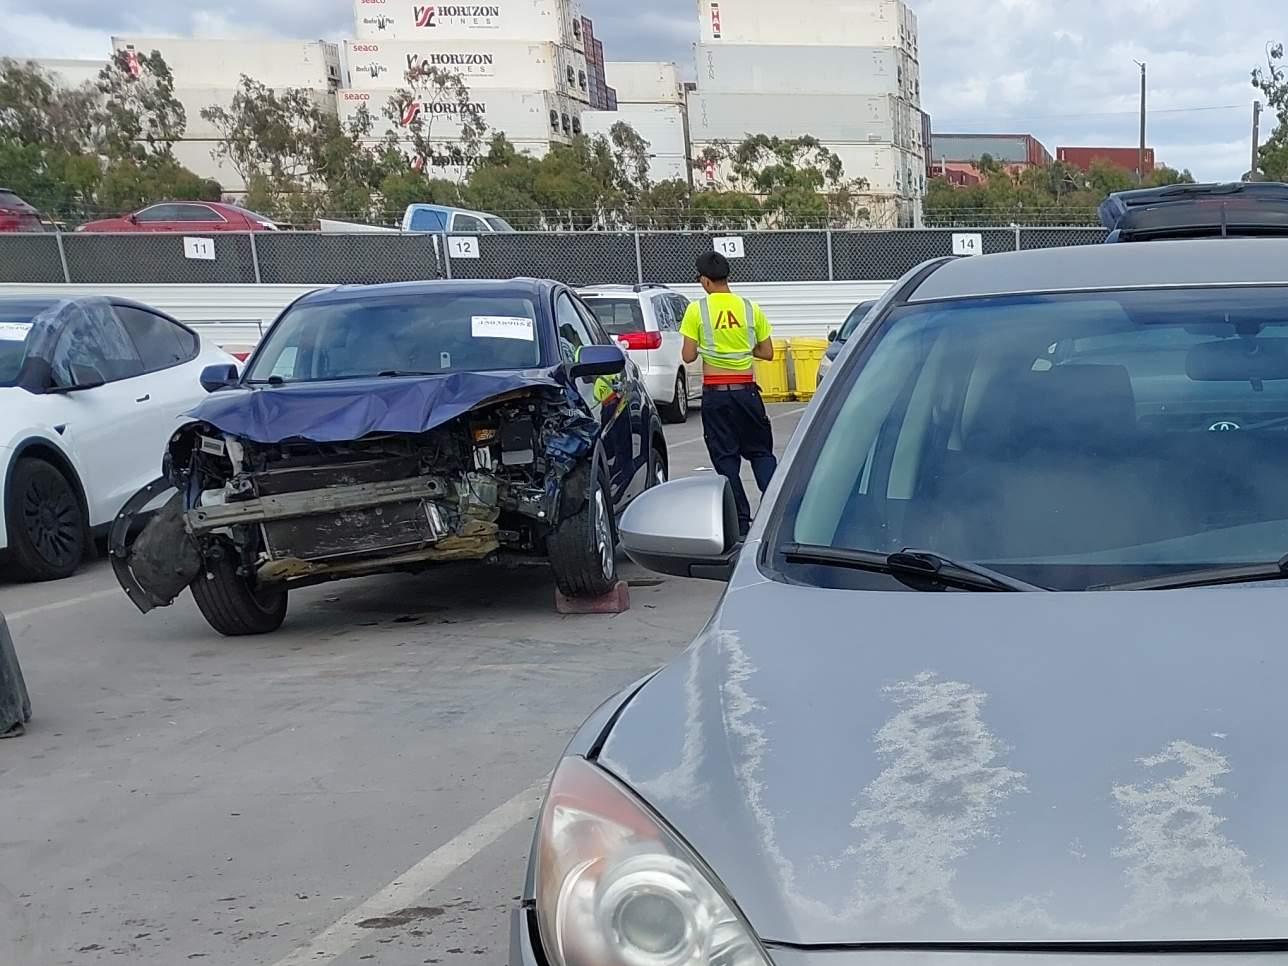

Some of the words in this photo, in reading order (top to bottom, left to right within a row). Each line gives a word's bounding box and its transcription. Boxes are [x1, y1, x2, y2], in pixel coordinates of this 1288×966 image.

[437, 6, 500, 17] HORIZON
[353, 44, 379, 52] seaco
[430, 54, 494, 65] HORIZON
[423, 103, 487, 113] HORIZON
[193, 243, 207, 254] 11
[456, 242, 471, 253] 12
[721, 242, 737, 253] 13
[960, 239, 974, 249] 14
